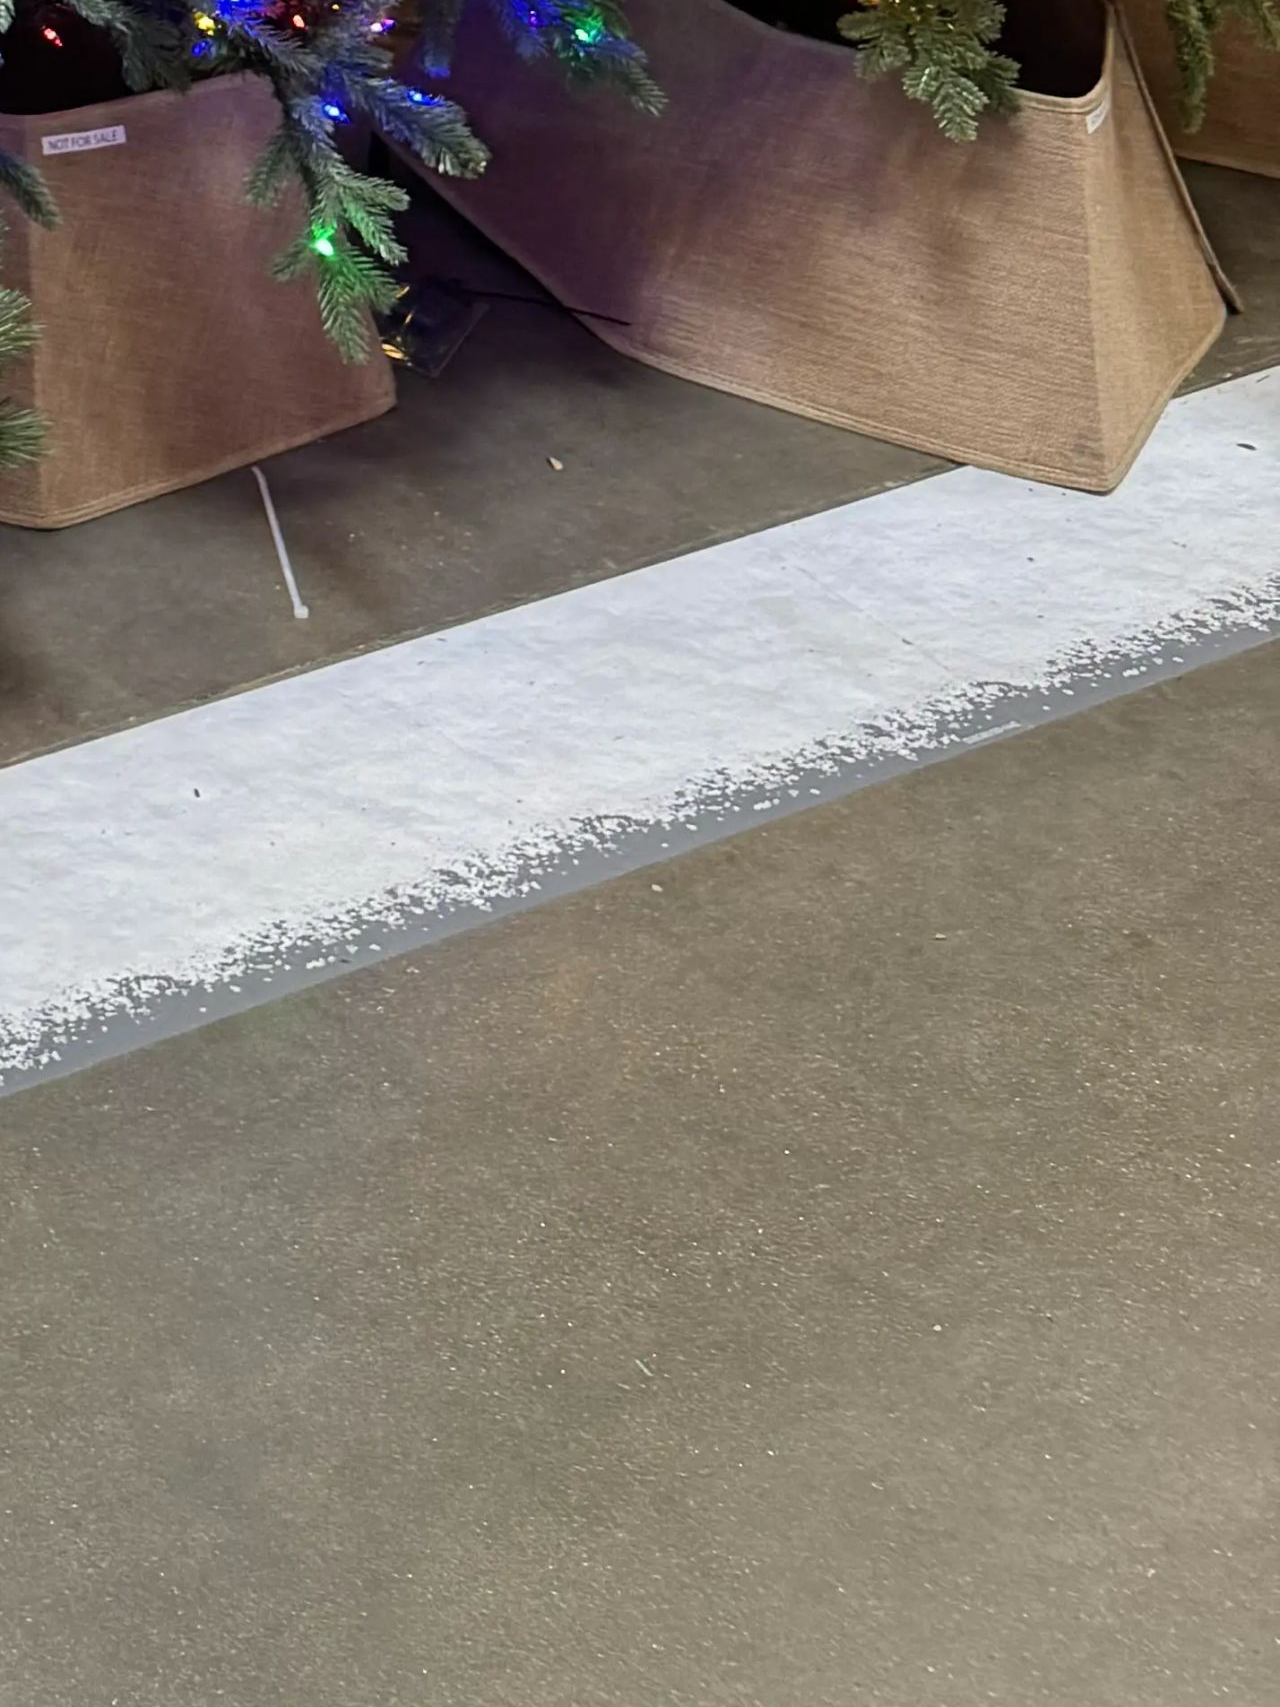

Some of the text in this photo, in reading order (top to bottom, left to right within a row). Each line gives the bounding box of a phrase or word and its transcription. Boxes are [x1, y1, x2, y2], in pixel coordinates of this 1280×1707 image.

[47, 128, 119, 151] NOT FOR SALE
